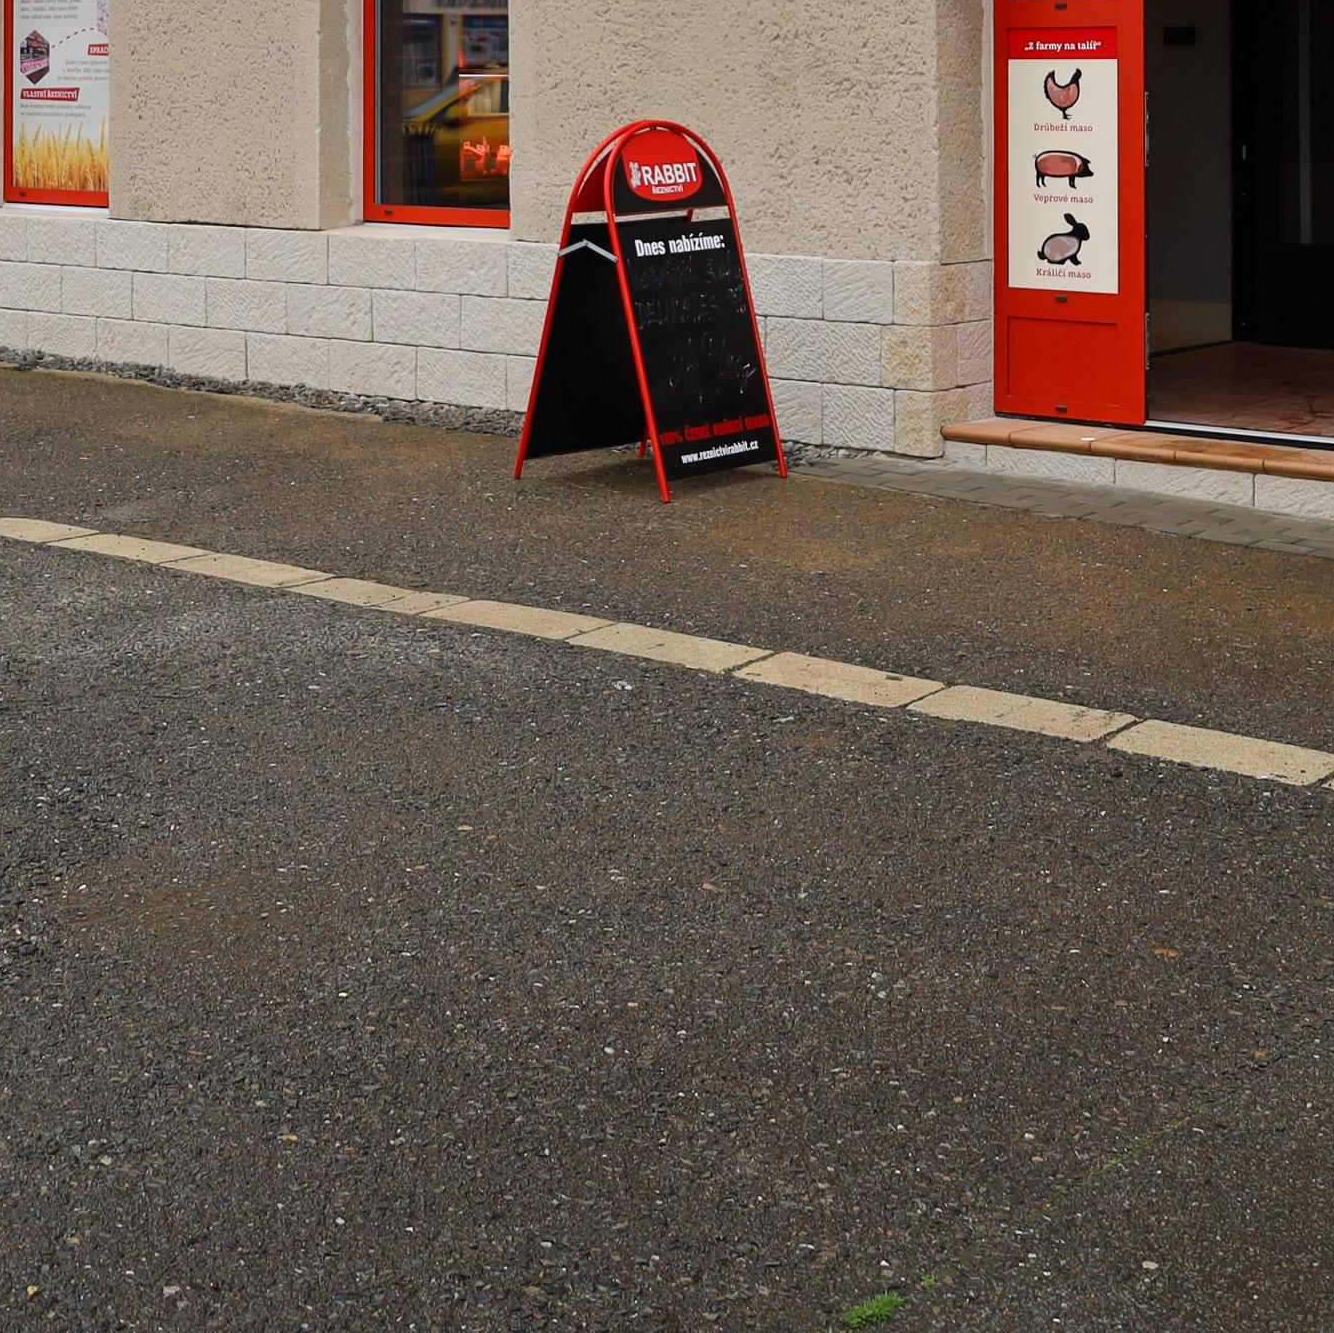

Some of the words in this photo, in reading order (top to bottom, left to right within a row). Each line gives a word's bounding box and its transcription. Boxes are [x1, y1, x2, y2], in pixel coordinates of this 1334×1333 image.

[1035, 41, 1063, 52] farmy
[1064, 42, 1075, 50] na
[1034, 122, 1067, 132] Drůbeží
[1070, 124, 1093, 132] maso
[640, 162, 697, 186] RABBIT
[652, 184, 684, 195] ŘEZNICTVÍ
[1033, 193, 1068, 204] Vepřové
[1070, 195, 1094, 204] maso
[634, 238, 666, 257] Dnes
[668, 231, 725, 254] nabízíme:
[1036, 267, 1066, 278] Králičí
[1068, 269, 1092, 279] maso
[681, 440, 759, 464] www.reznictvirabbit.cz
